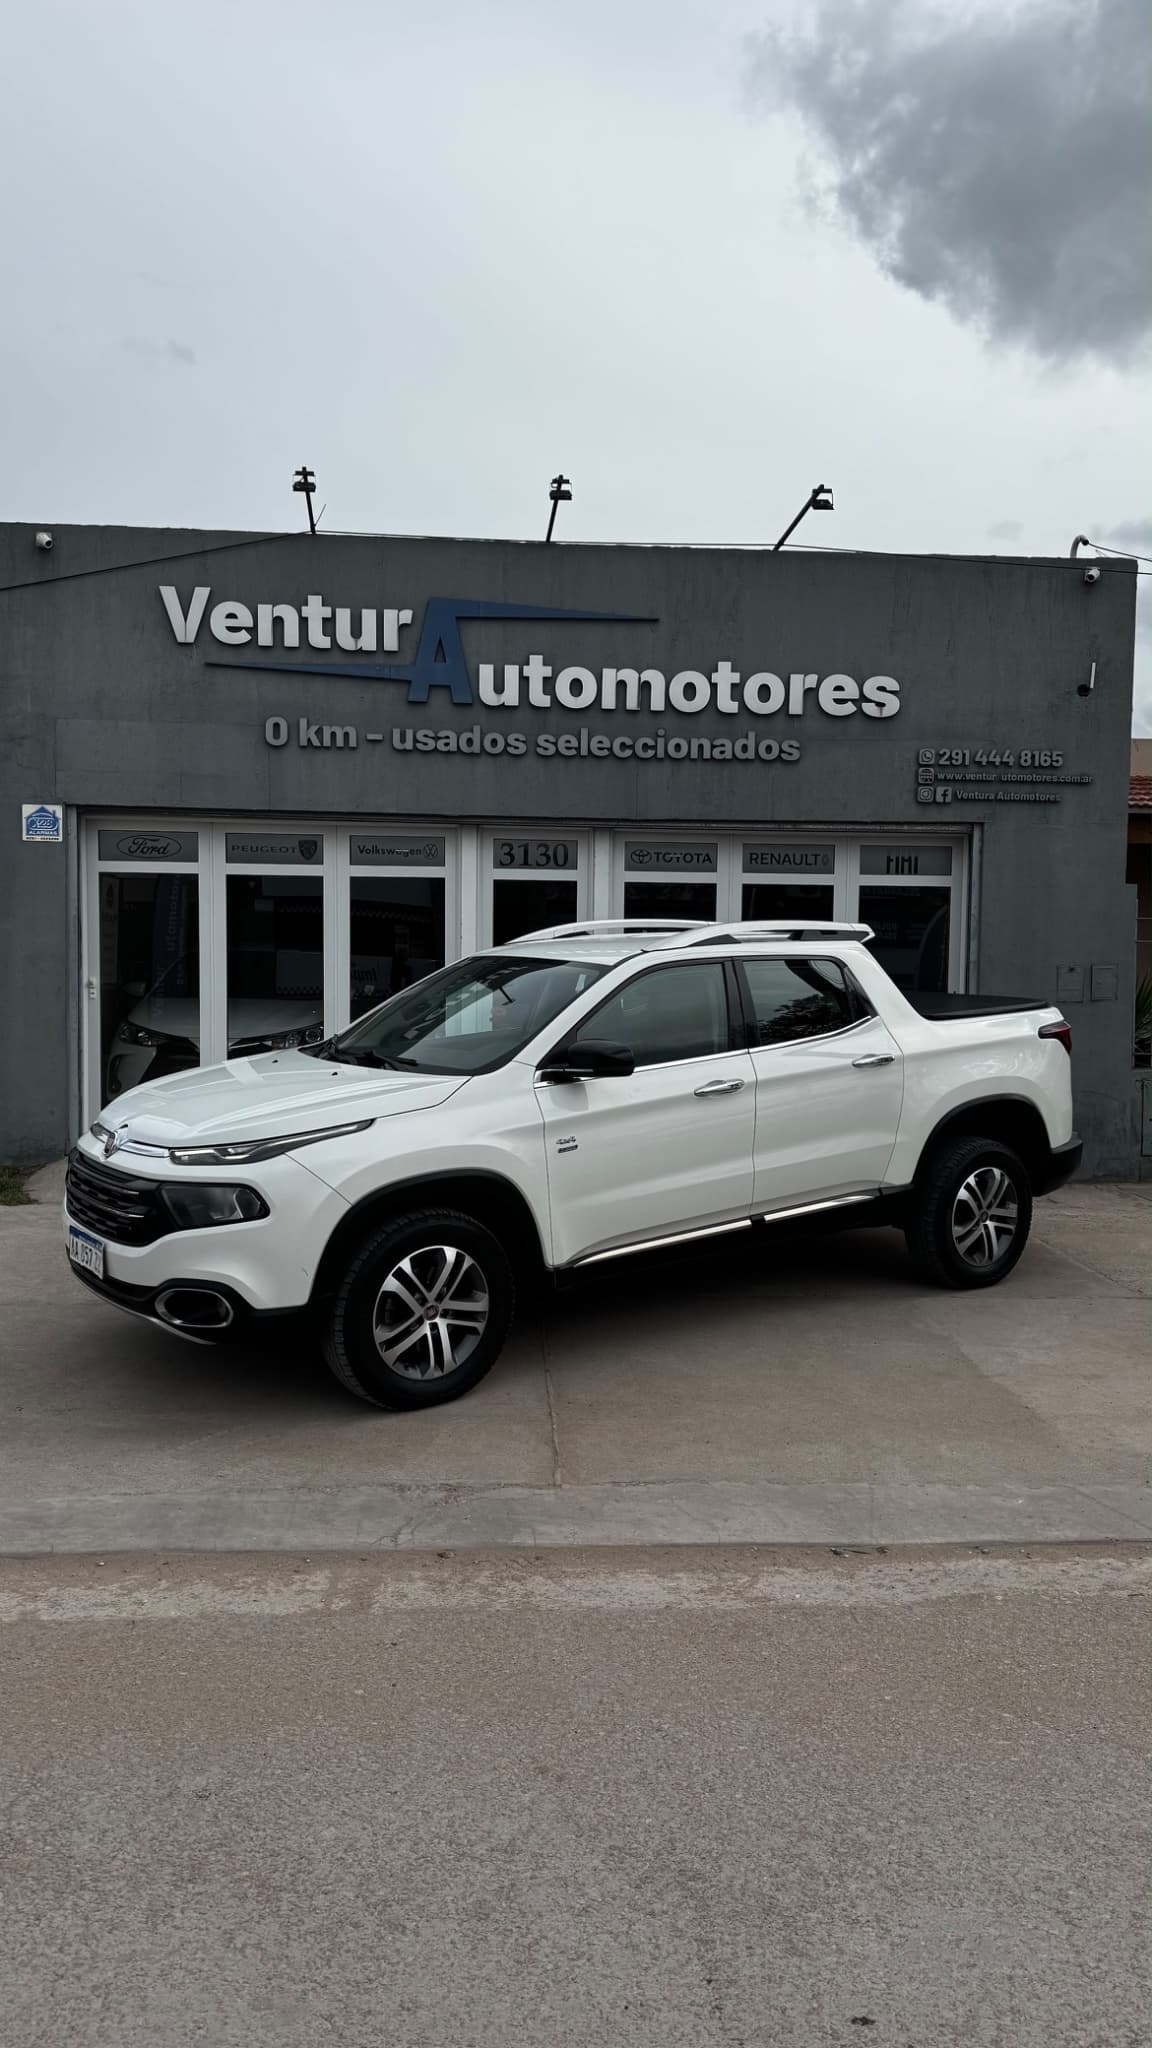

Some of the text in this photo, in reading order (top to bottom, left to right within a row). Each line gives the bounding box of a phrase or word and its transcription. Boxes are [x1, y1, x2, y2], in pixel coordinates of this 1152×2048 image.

[264, 716, 289, 747] 0
[299, 717, 358, 748] km
[392, 725, 528, 756] usados
[535, 727, 801, 761] seleccionados
[938, 749, 1063, 767] 291 444 8165
[956, 790, 995, 800] Ventura
[127, 837, 170, 856] Ford
[231, 844, 298, 854] PEUGEOT
[357, 845, 422, 858] Volkswagen
[499, 842, 569, 868] 3130
[653, 851, 713, 865] TOYOTA
[749, 852, 821, 866] RENAULT
